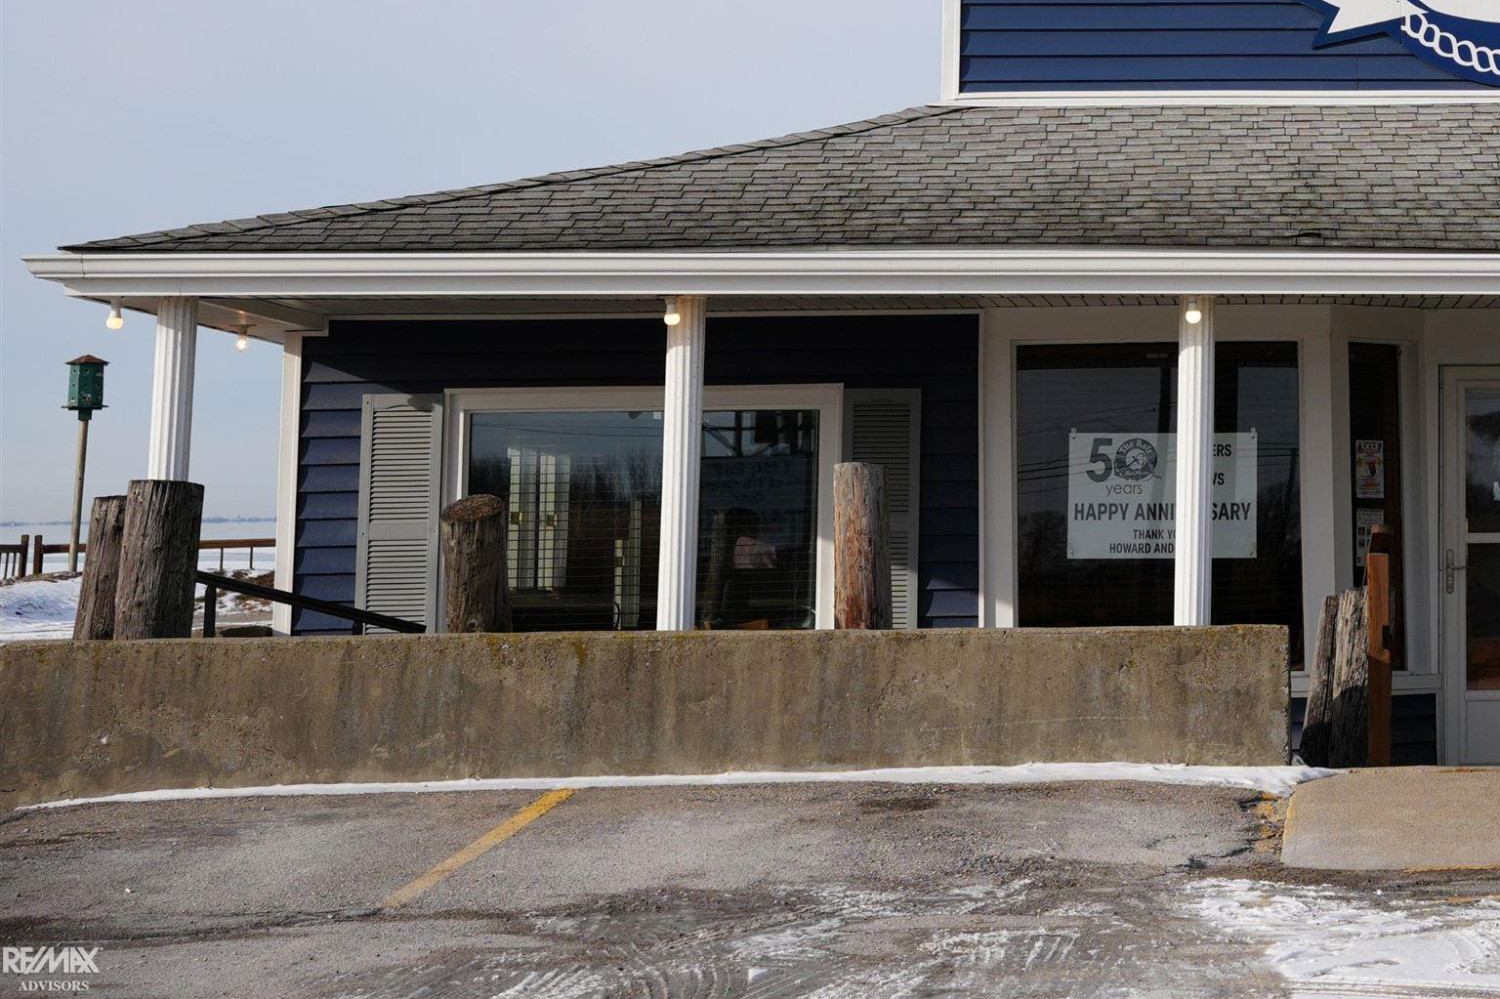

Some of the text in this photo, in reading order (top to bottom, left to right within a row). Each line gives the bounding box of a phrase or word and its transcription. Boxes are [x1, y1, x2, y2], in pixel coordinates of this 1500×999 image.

[1105, 483, 1143, 497] years
[1074, 502, 1129, 521] HAPPY
[1133, 529, 1164, 540] THANK
[1109, 543, 1175, 554] HOWARD AND
